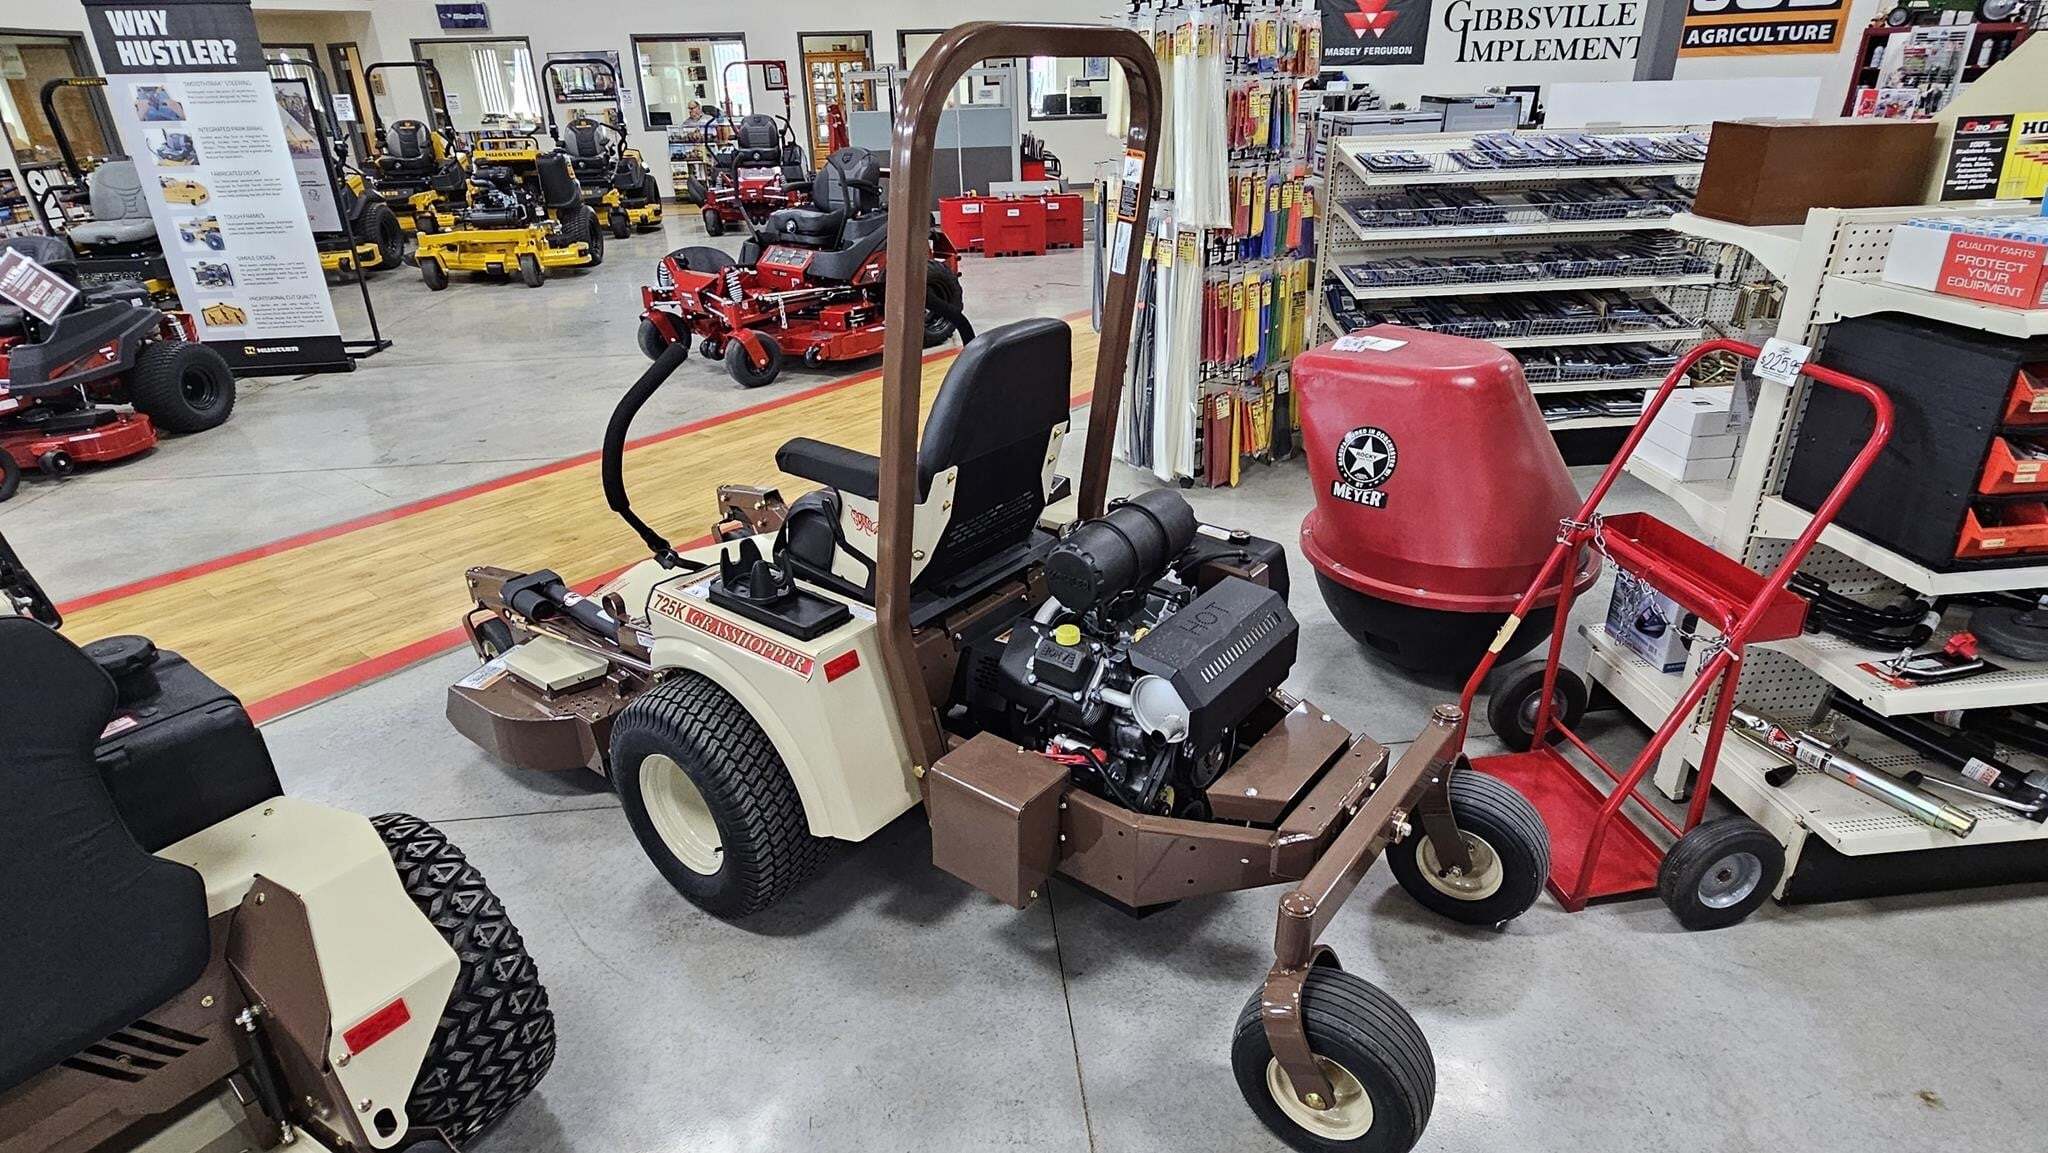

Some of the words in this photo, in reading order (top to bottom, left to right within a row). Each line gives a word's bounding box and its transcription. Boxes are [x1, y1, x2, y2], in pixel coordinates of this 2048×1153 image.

[104, 10, 169, 36] WHY
[1444, 0, 1638, 33] GIBBSVILLE
[1686, 24, 1833, 45] AGRICULTURE
[114, 39, 238, 66] HUSTLER?
[1324, 47, 1362, 56] MASSEY
[1363, 46, 1413, 56] FERGUSON
[1956, 240, 2000, 253] QUALITY
[2000, 246, 2037, 259] PARTS
[1954, 253, 2029, 274] PROTECT
[1967, 267, 2010, 284] YOUR
[1946, 276, 2025, 298] EQUIPMENT
[1355, 450, 1378, 460] ROCKY
[1179, 601, 1230, 636] HOT
[653, 593, 688, 621] 725K
[690, 611, 806, 672] GRASSHOPPER
